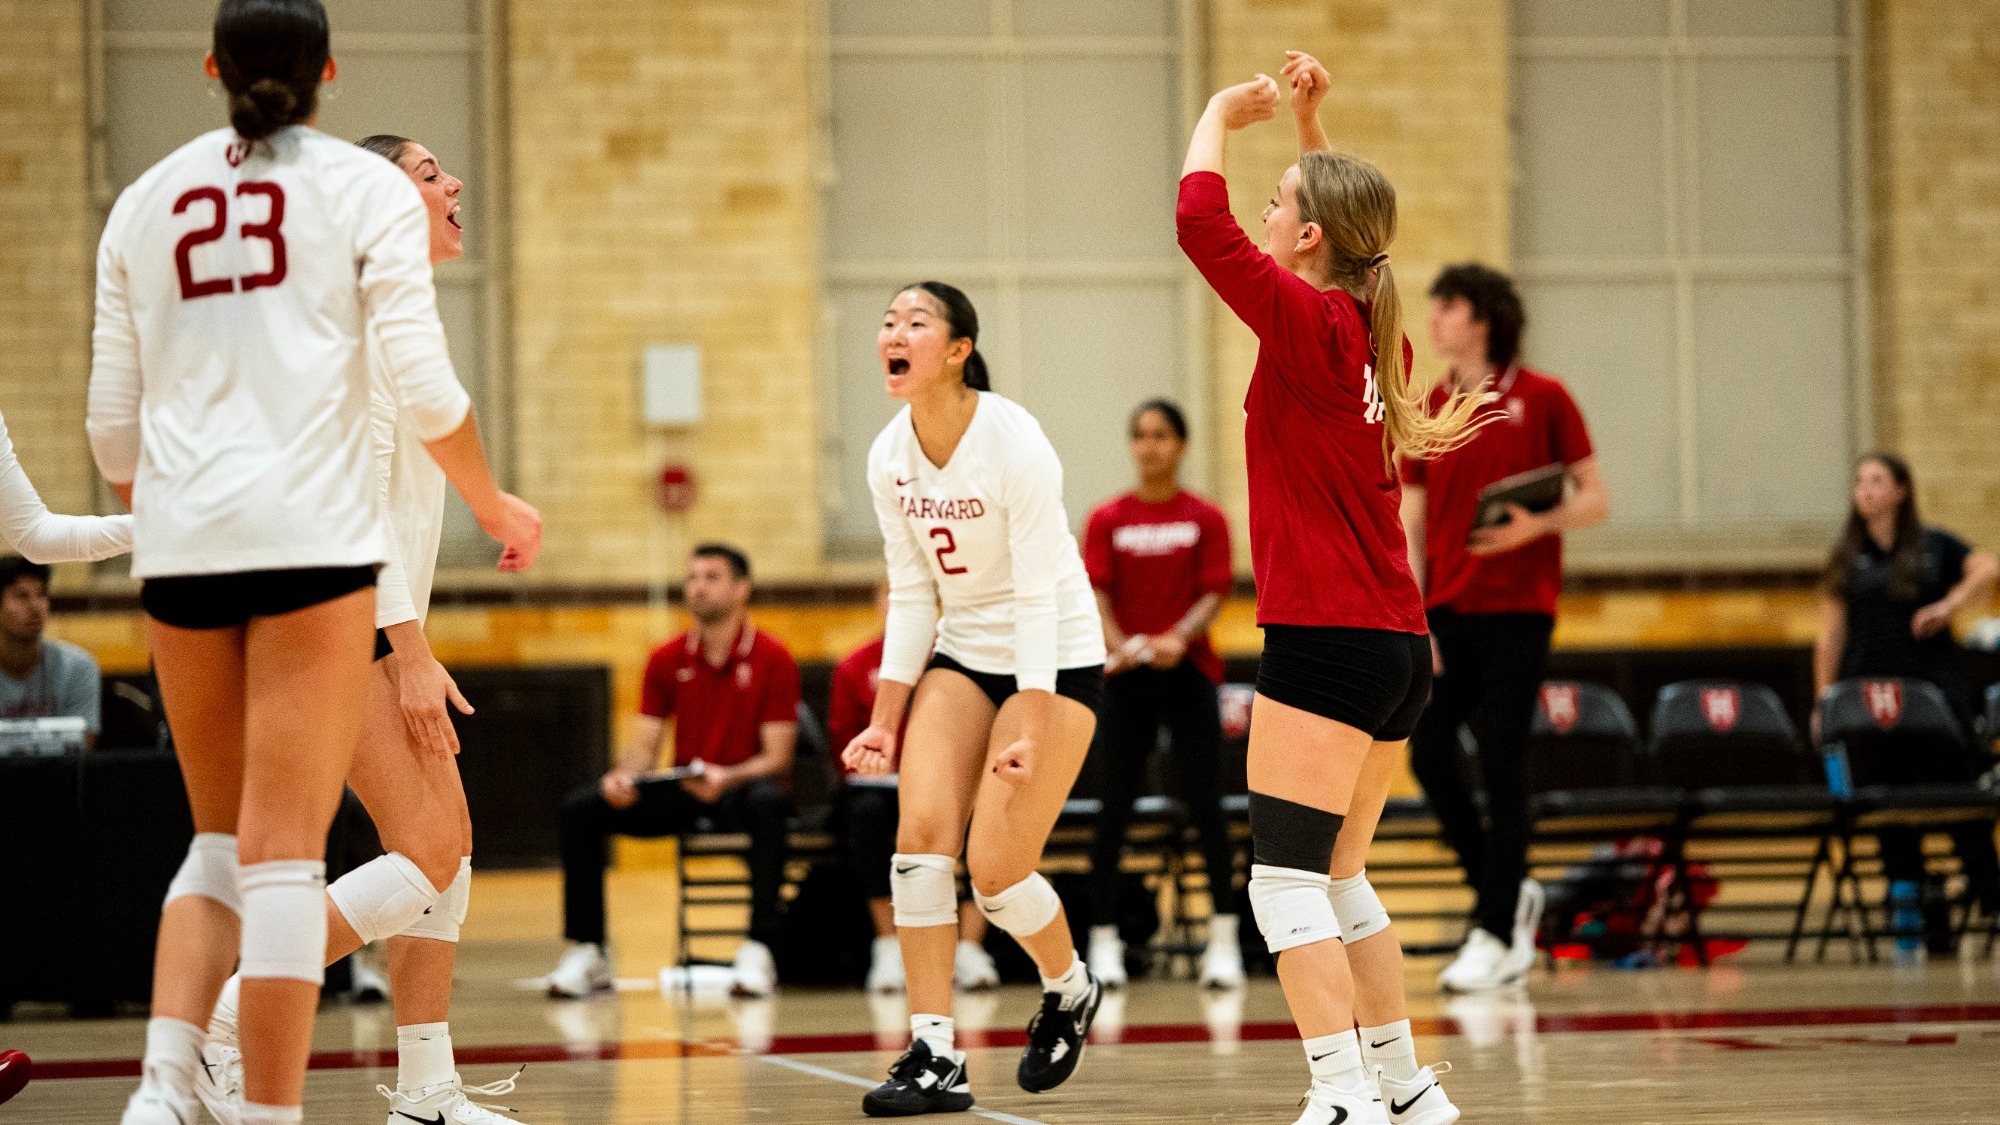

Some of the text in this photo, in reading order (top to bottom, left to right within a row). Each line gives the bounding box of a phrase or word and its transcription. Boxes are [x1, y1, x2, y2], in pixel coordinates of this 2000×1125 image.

[172, 180, 288, 301] 23
[1362, 363, 1385, 425] 1
[929, 527, 968, 575] 2
